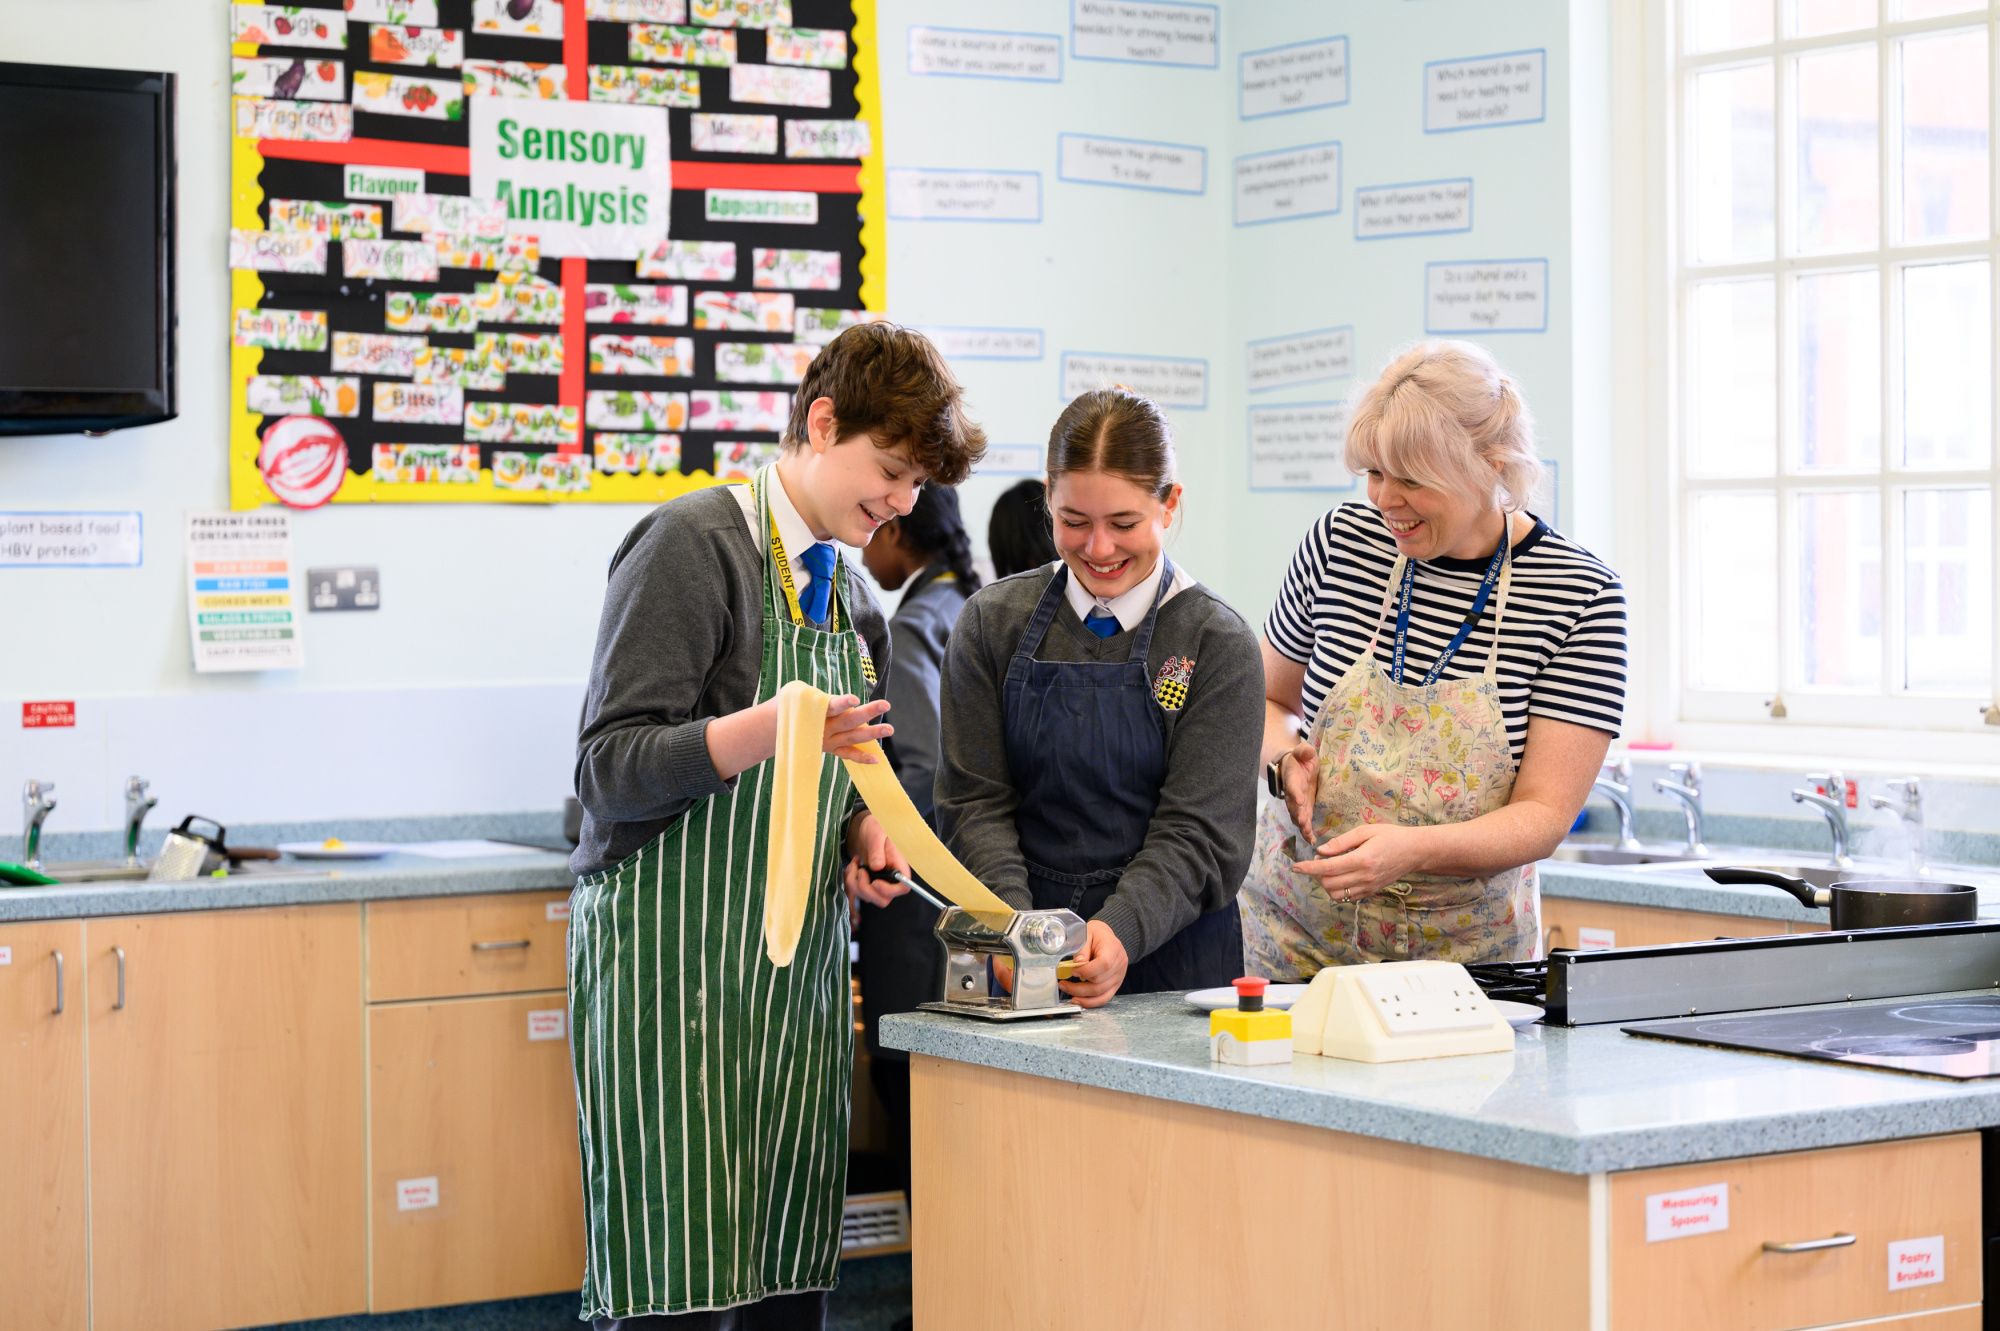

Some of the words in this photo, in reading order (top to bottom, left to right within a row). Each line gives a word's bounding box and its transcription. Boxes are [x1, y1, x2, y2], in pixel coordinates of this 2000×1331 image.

[263, 11, 321, 35] Tugh
[387, 31, 448, 53] Elastic
[254, 105, 335, 129] Fragrant
[498, 119, 645, 169] Sensory
[350, 174, 419, 195] Flavour
[496, 180, 648, 227] Analysis
[710, 196, 811, 218] Appearance
[256, 236, 300, 257] Cool
[238, 315, 321, 340] Lemony
[392, 389, 446, 409] Bitter
[394, 451, 464, 468] Tainted
[0, 520, 34, 537] plant
[39, 520, 82, 534] based
[88, 519, 121, 534] food
[192, 517, 243, 526] PREVENT
[247, 517, 287, 526] CROSS
[190, 531, 288, 541] CONTAMINATION
[1, 543, 32, 556] HBV
[37, 543, 98, 560] protein?
[772, 537, 794, 590] STUDENT
[1405, 563, 1413, 582] COAT
[1485, 571, 1496, 585] THE
[1491, 551, 1504, 572] BLUE
[218, 580, 241, 590] RAW
[204, 597, 246, 606] COOKED
[250, 596, 283, 605] MEATS
[1401, 583, 1411, 614] SCHOOL
[252, 612, 289, 623] FRUITS
[1397, 631, 1405, 645] THE
[1395, 646, 1403, 667] BLUE
[1432, 649, 1454, 675] SCHOOL
[1393, 668, 1402, 686] COA
[30, 703, 68, 714] CAUTION
[24, 715, 41, 726] HOT
[46, 713, 75, 725] WATER
[1661, 1194, 1718, 1210] Measuring
[1671, 1215, 1709, 1229] Spoons
[1900, 1253, 1931, 1264] Pastry
[1897, 1269, 1935, 1283] Brushes
